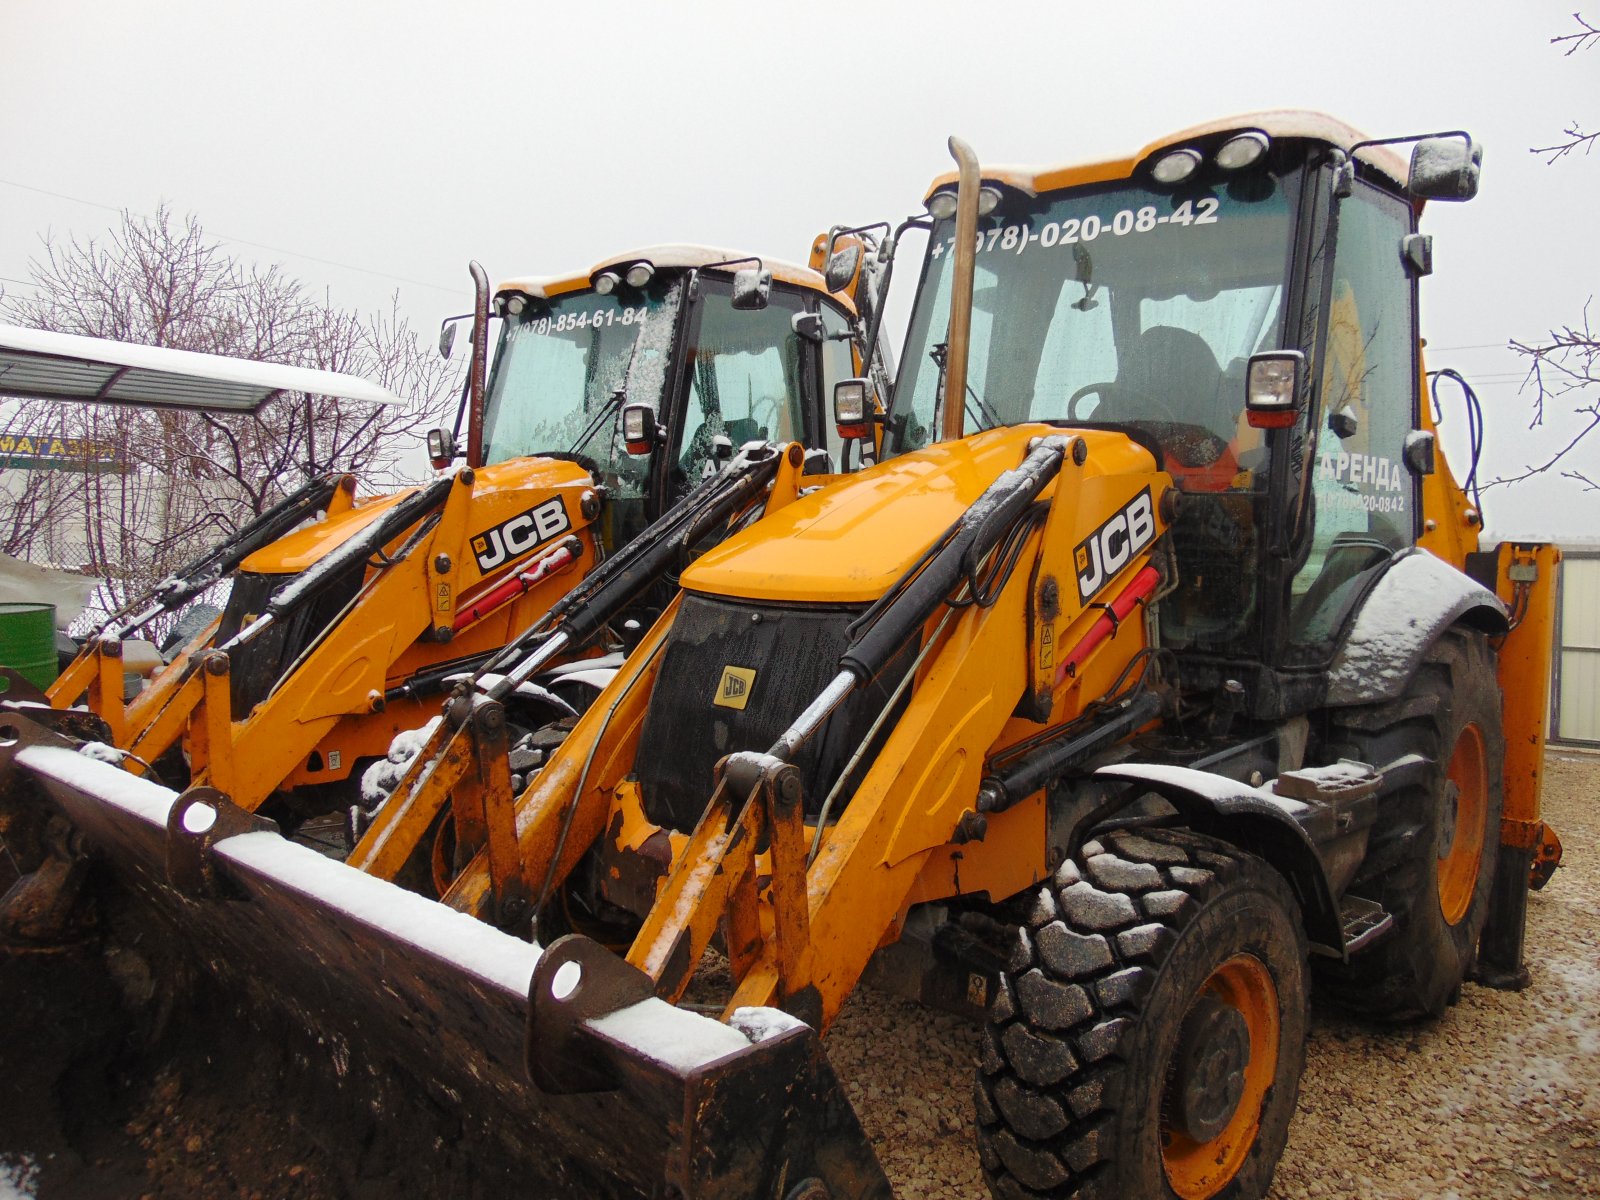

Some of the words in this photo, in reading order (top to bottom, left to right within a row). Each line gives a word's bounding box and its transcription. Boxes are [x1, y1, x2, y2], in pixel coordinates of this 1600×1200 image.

[932, 197, 1220, 260] +7978)-020-08-42
[1318, 451, 1402, 492] АРЕНДА
[478, 500, 568, 569] JCB
[1079, 493, 1154, 597] JCB
[725, 675, 745, 696] JCB
